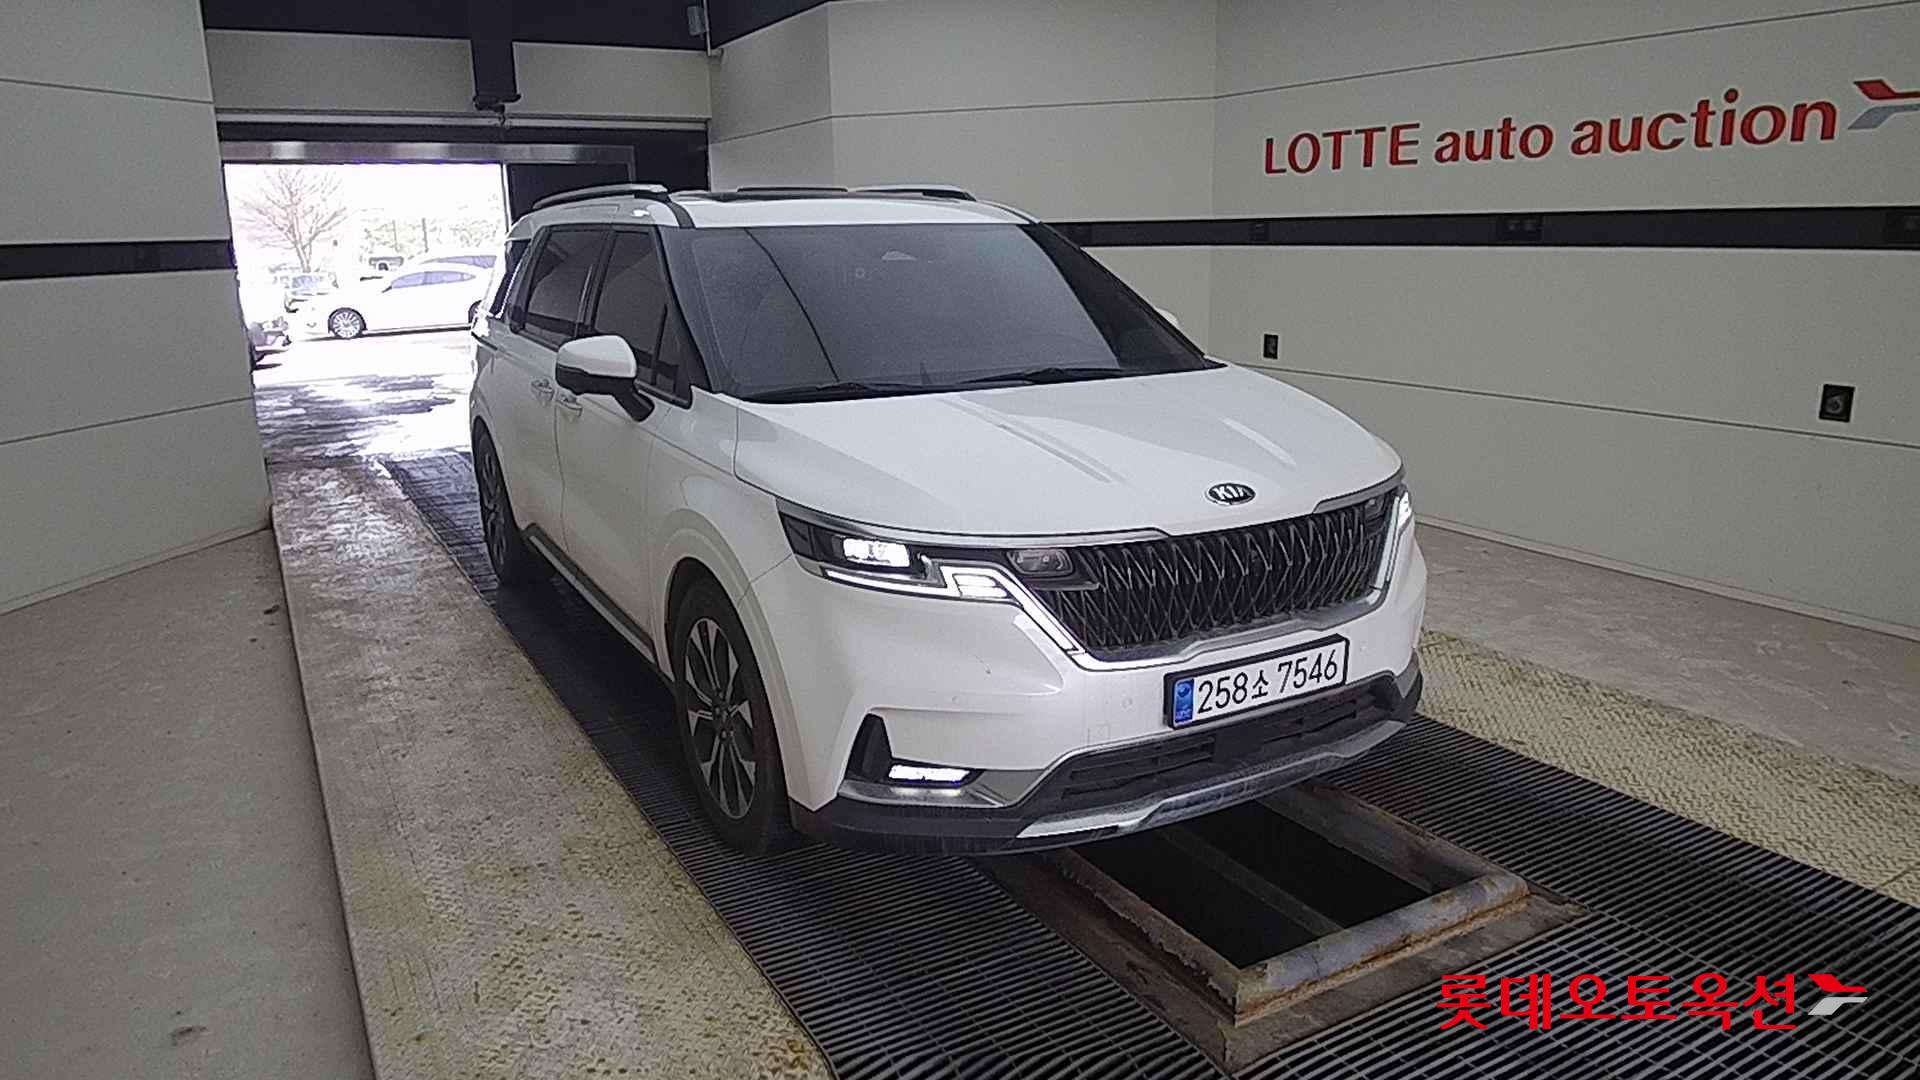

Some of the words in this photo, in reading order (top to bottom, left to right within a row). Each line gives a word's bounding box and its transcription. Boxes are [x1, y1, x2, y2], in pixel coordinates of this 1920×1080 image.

[1264, 123, 1421, 174] LOTTE
[1434, 117, 1554, 163] auto
[1570, 88, 1837, 156] auction
[1211, 485, 1252, 500] KIA
[1198, 671, 1269, 714] 258소
[1278, 649, 1338, 693] 7546
